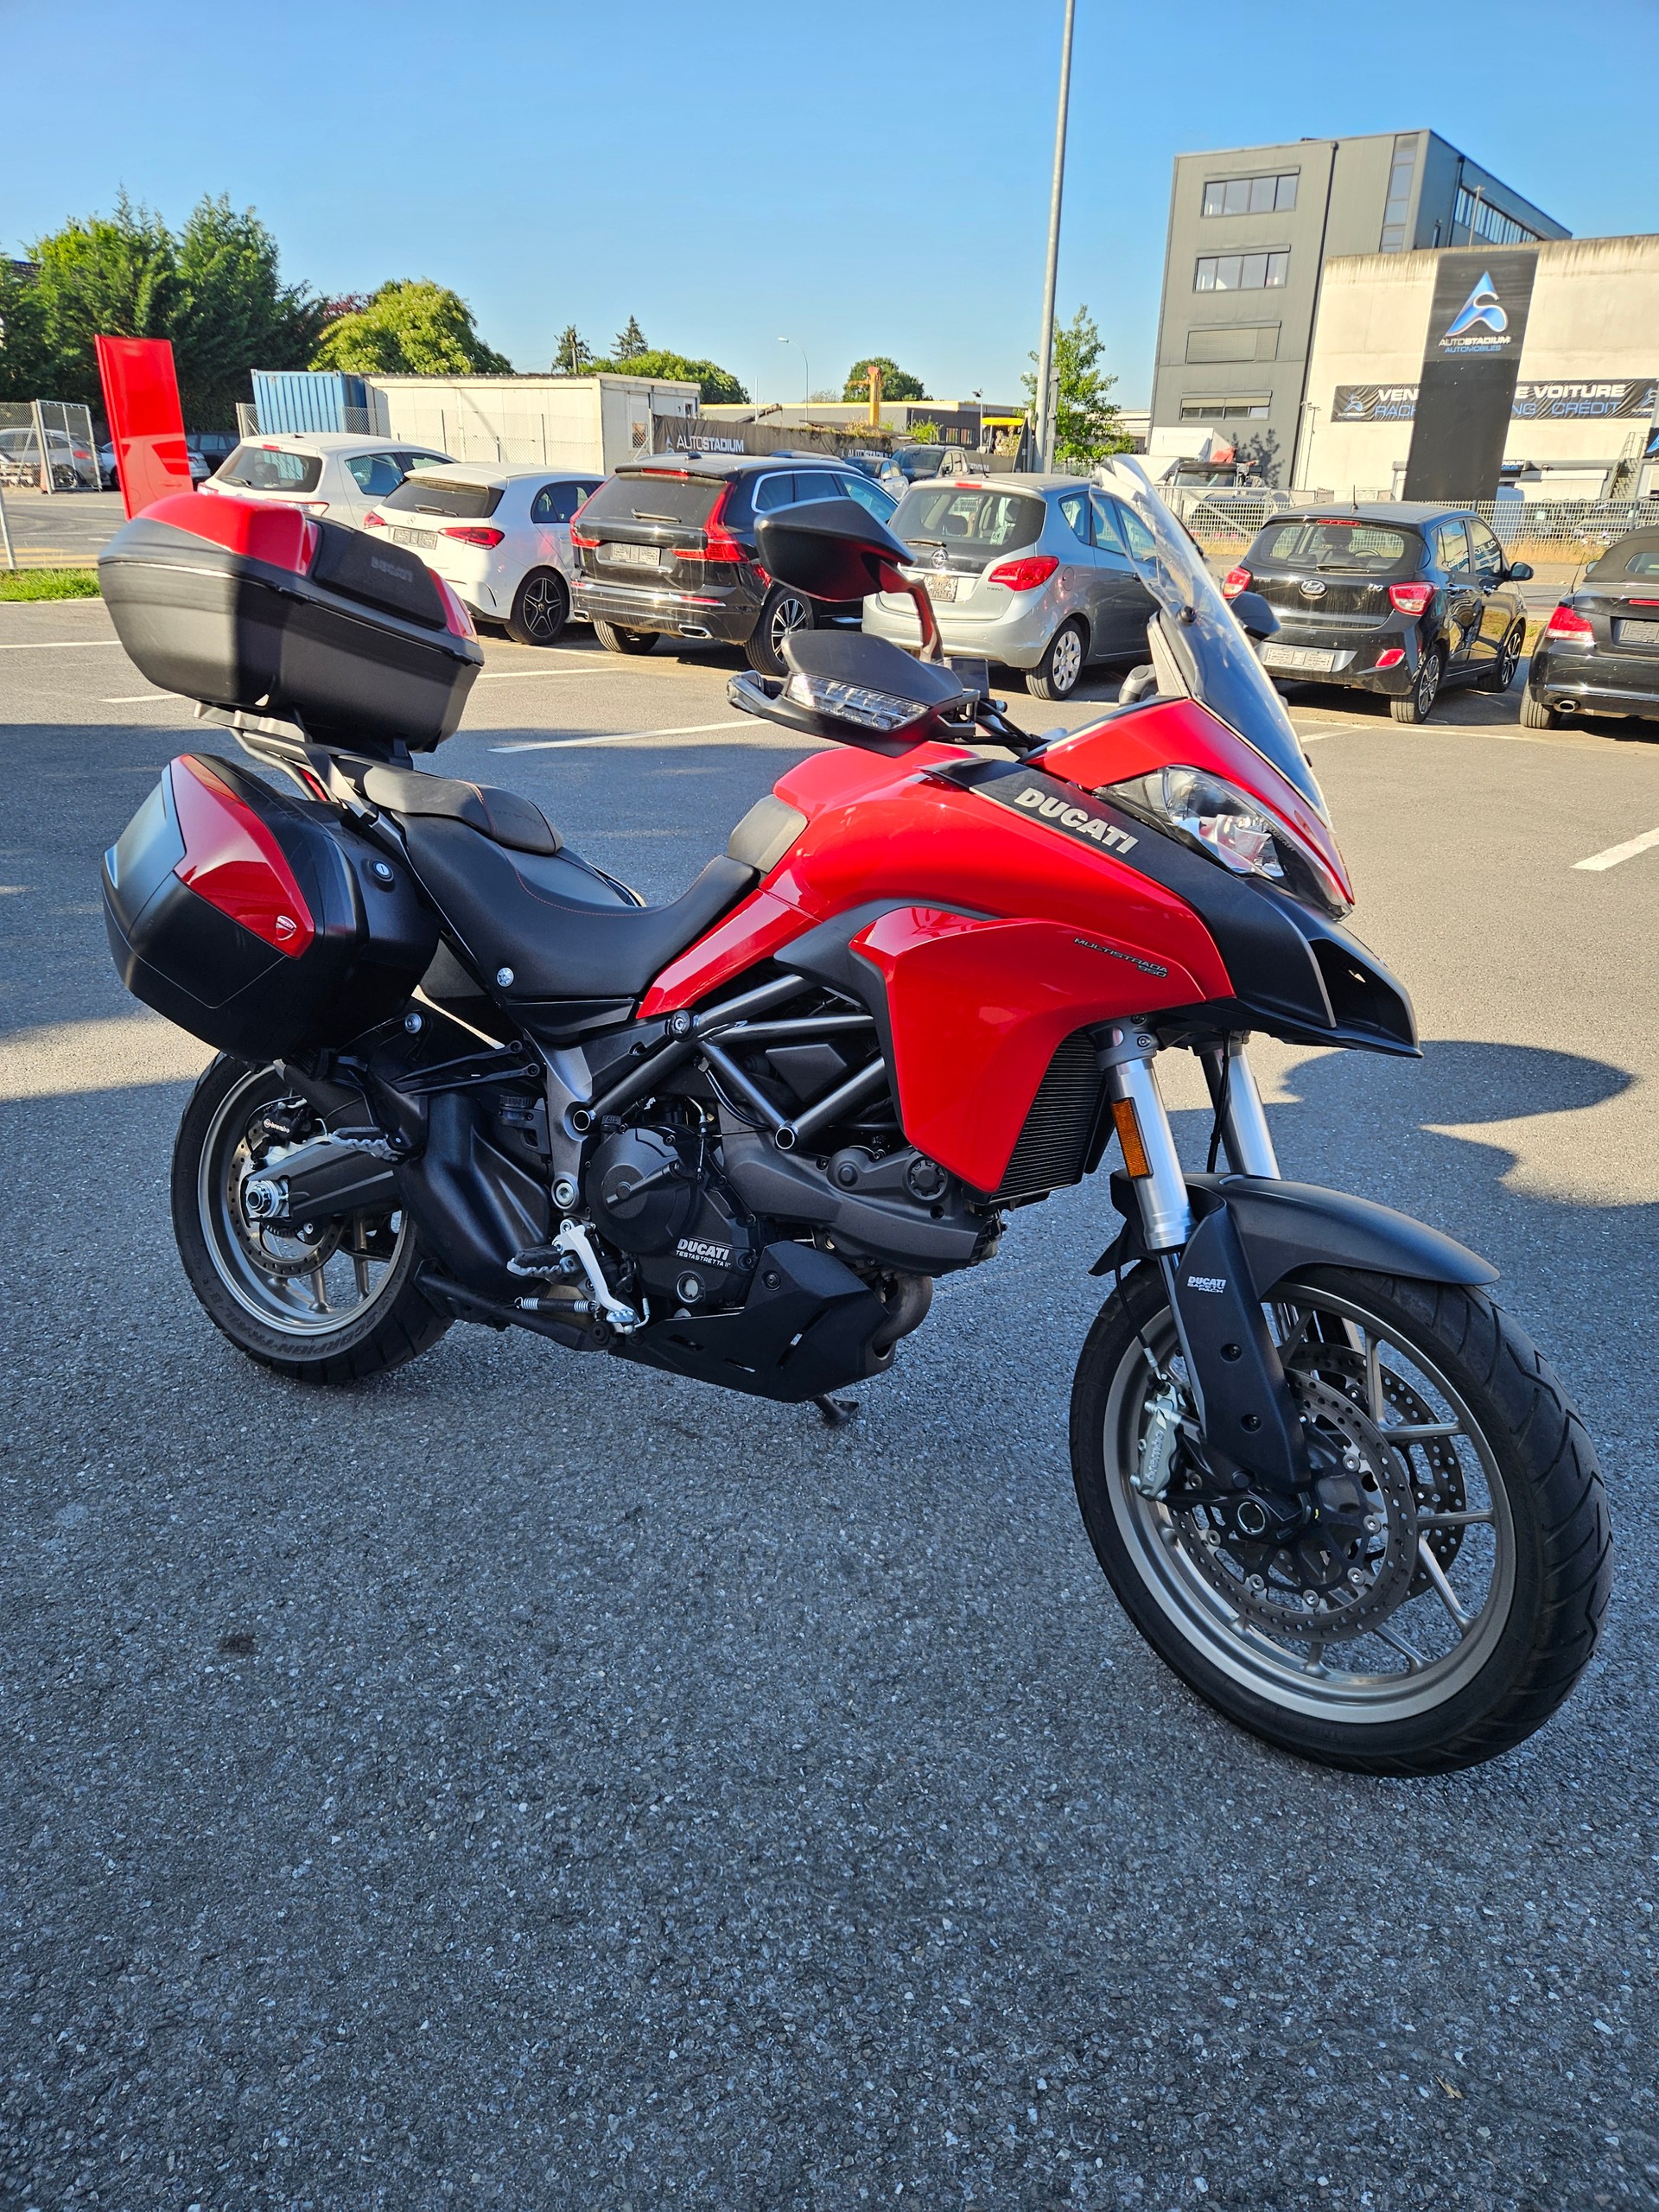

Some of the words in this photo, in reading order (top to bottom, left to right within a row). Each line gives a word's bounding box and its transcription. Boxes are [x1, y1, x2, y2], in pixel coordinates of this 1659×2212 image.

[1438, 335, 1511, 346] AUTOSTADIUM
[1445, 345, 1502, 353] AUTOMOBILES
[1533, 385, 1626, 399] VOITURE
[1551, 400, 1622, 415] CRÉDIT
[677, 435, 745, 453] AUTOSTADIUM
[1014, 787, 1140, 855] DUCATI
[1074, 938, 1167, 973] MULTISTRADA
[1137, 964, 1167, 978] 950
[677, 1238, 730, 1261] DUCATI
[676, 1249, 724, 1267] TESTASTRETTA
[1188, 1276, 1227, 1287] DUCATI
[1145, 1429, 1164, 1483] brembo
